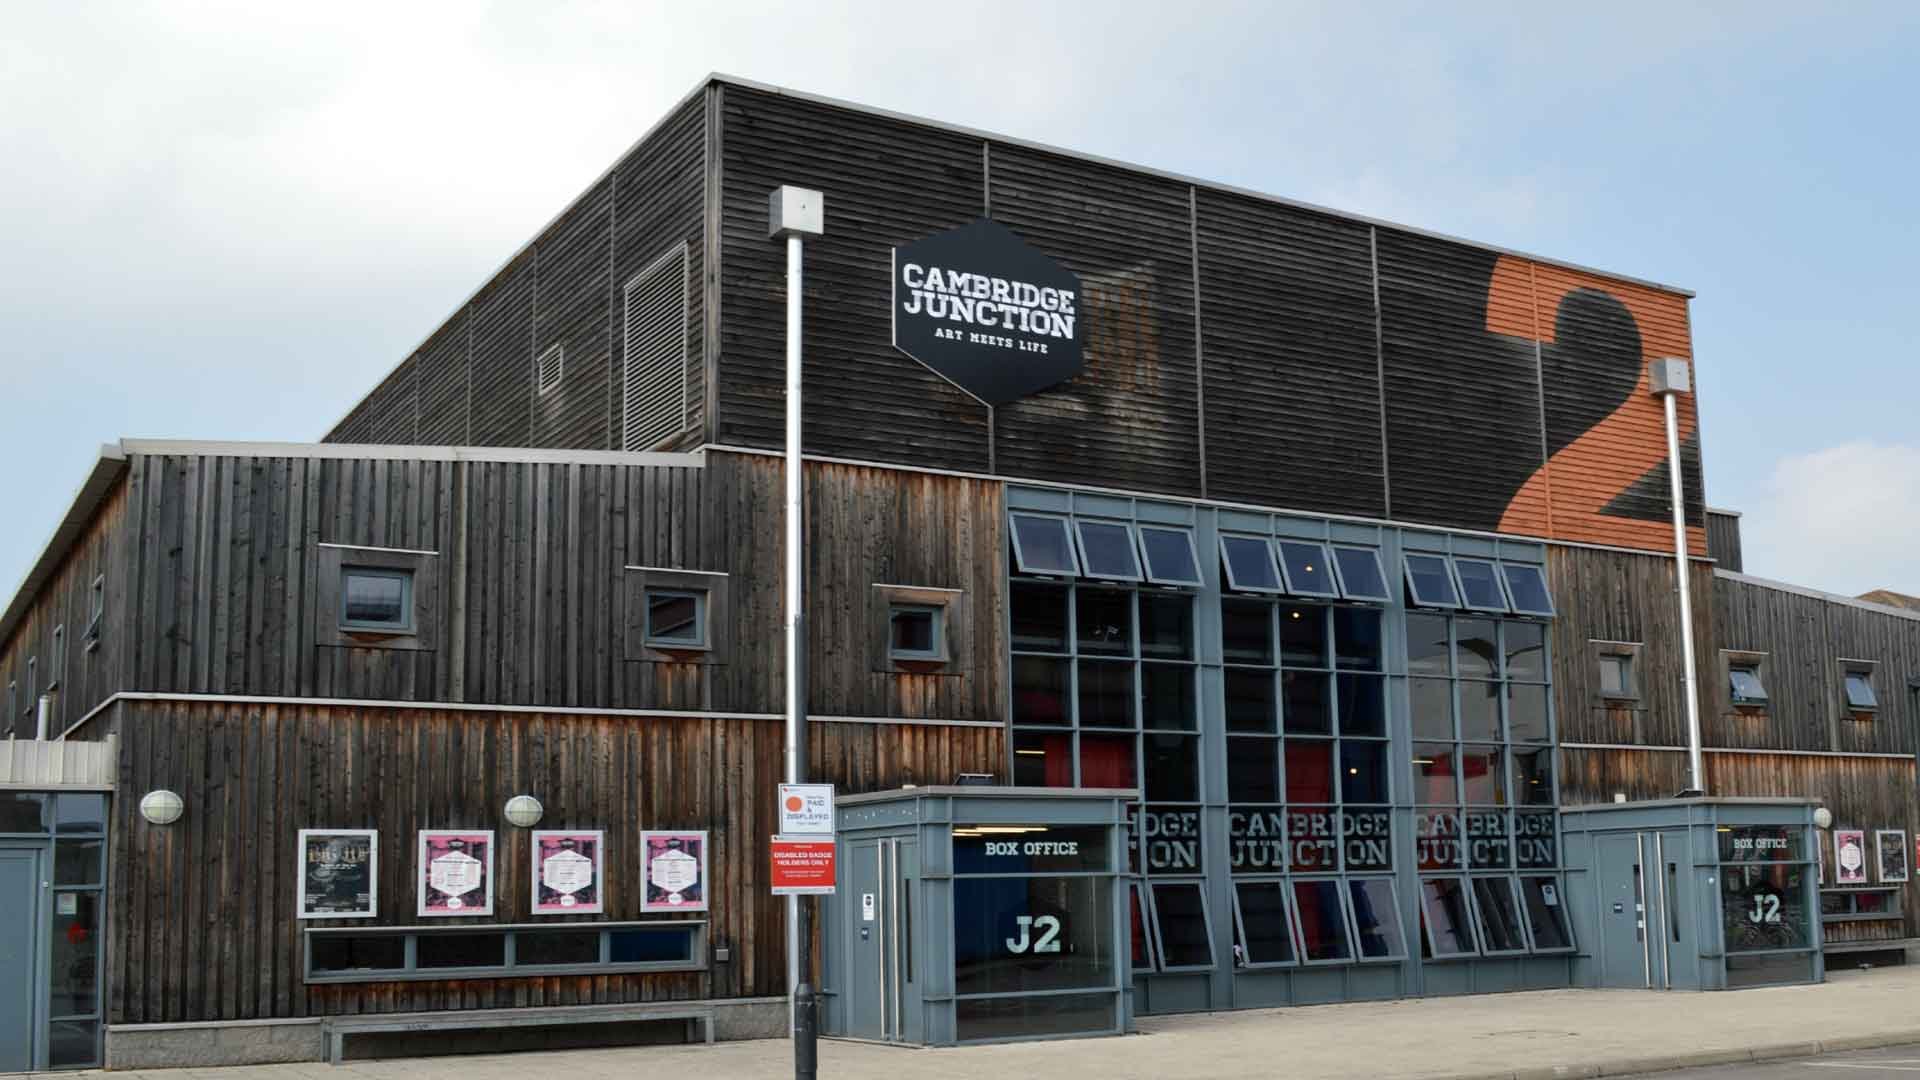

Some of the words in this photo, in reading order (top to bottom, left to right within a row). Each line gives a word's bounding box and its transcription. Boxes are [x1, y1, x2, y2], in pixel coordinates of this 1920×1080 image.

[903, 263, 1075, 315] CAMBRIDGE
[903, 290, 1076, 339] JUNCTION
[935, 328, 963, 341] ART
[970, 332, 1013, 348] MEETS
[1019, 339, 1048, 354] LIFE
[1486, 256, 1706, 555] 2
[985, 842, 1019, 855] BOX
[1024, 841, 1078, 855] OFFICE
[1231, 840, 1387, 866] JUNCTON
[1418, 839, 1552, 864] JUNCTON
[1734, 838, 1753, 848] BOX
[1755, 838, 1787, 848] OFFICE
[1749, 894, 1781, 922] J2
[1006, 915, 1060, 953] J2
